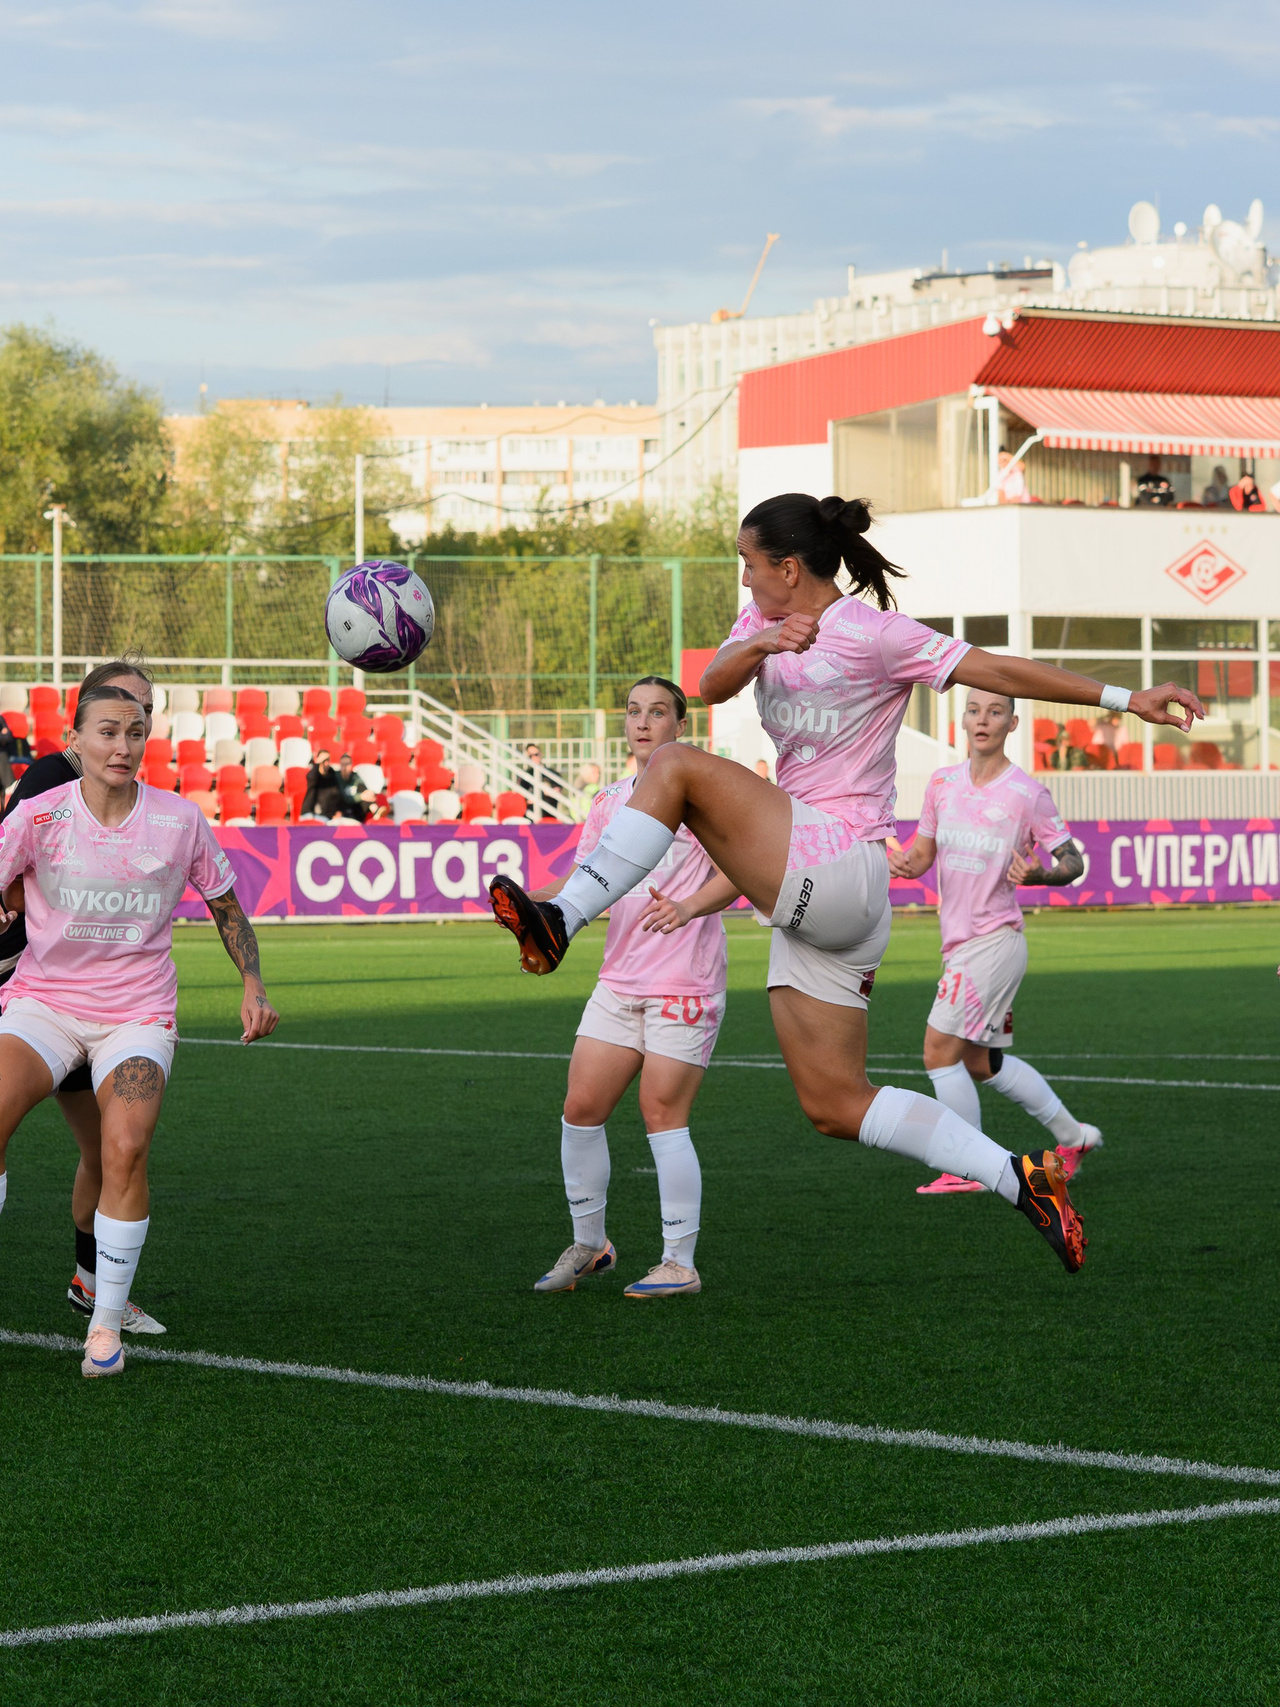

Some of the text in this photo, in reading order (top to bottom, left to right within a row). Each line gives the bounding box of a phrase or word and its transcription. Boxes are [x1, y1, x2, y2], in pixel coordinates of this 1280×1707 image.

[147, 812, 179, 822] КИБЕР
[147, 818, 189, 830] ПРОТЕКТ
[59, 887, 161, 914] ЛУКОЙЛ
[68, 926, 125, 939] WINLINE
